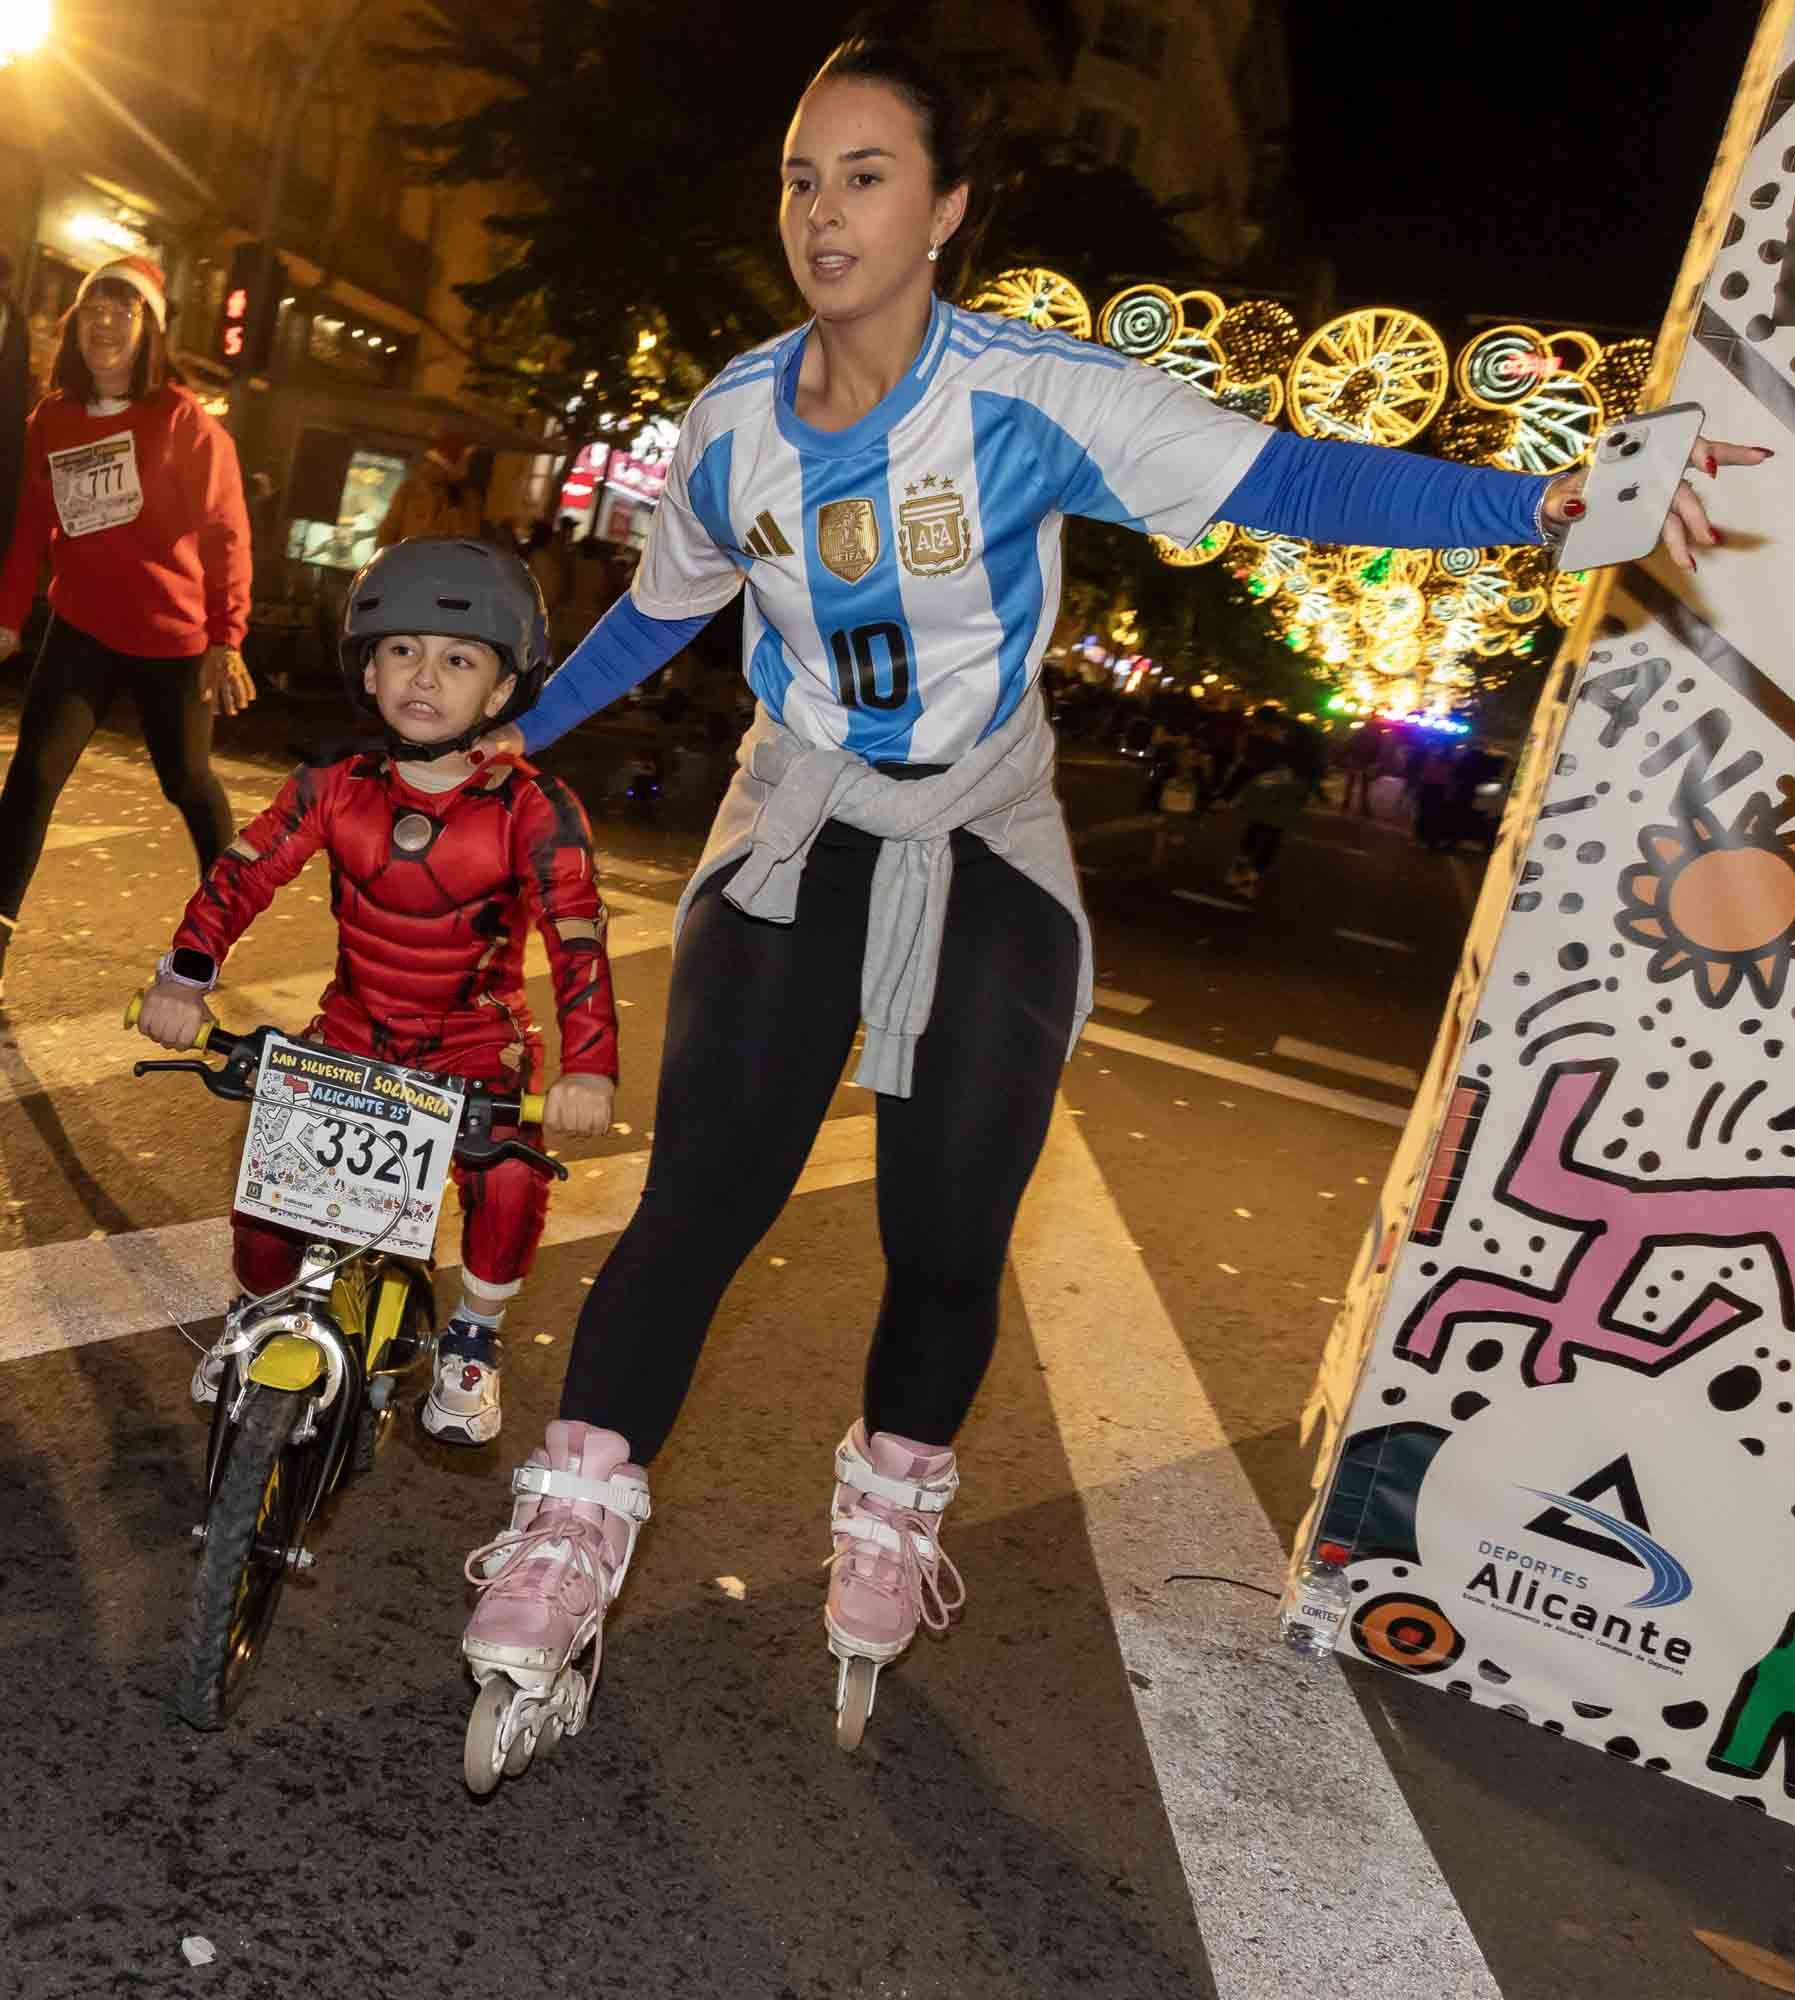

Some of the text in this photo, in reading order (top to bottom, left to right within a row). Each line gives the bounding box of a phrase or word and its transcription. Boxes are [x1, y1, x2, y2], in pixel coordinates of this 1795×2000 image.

[87, 463, 124, 497] 777
[917, 519, 953, 553] AFA
[830, 621, 909, 711] 10
[271, 1051, 450, 1116] SAN SILVESTRE SOLIDARIA
[312, 1087, 384, 1115] ALICANTE
[316, 1117, 435, 1191] 3321
[1479, 1540, 1589, 1589] DEPORTES
[1302, 1605, 1339, 1623] CORTES
[1466, 1562, 1692, 1665] Alicante
